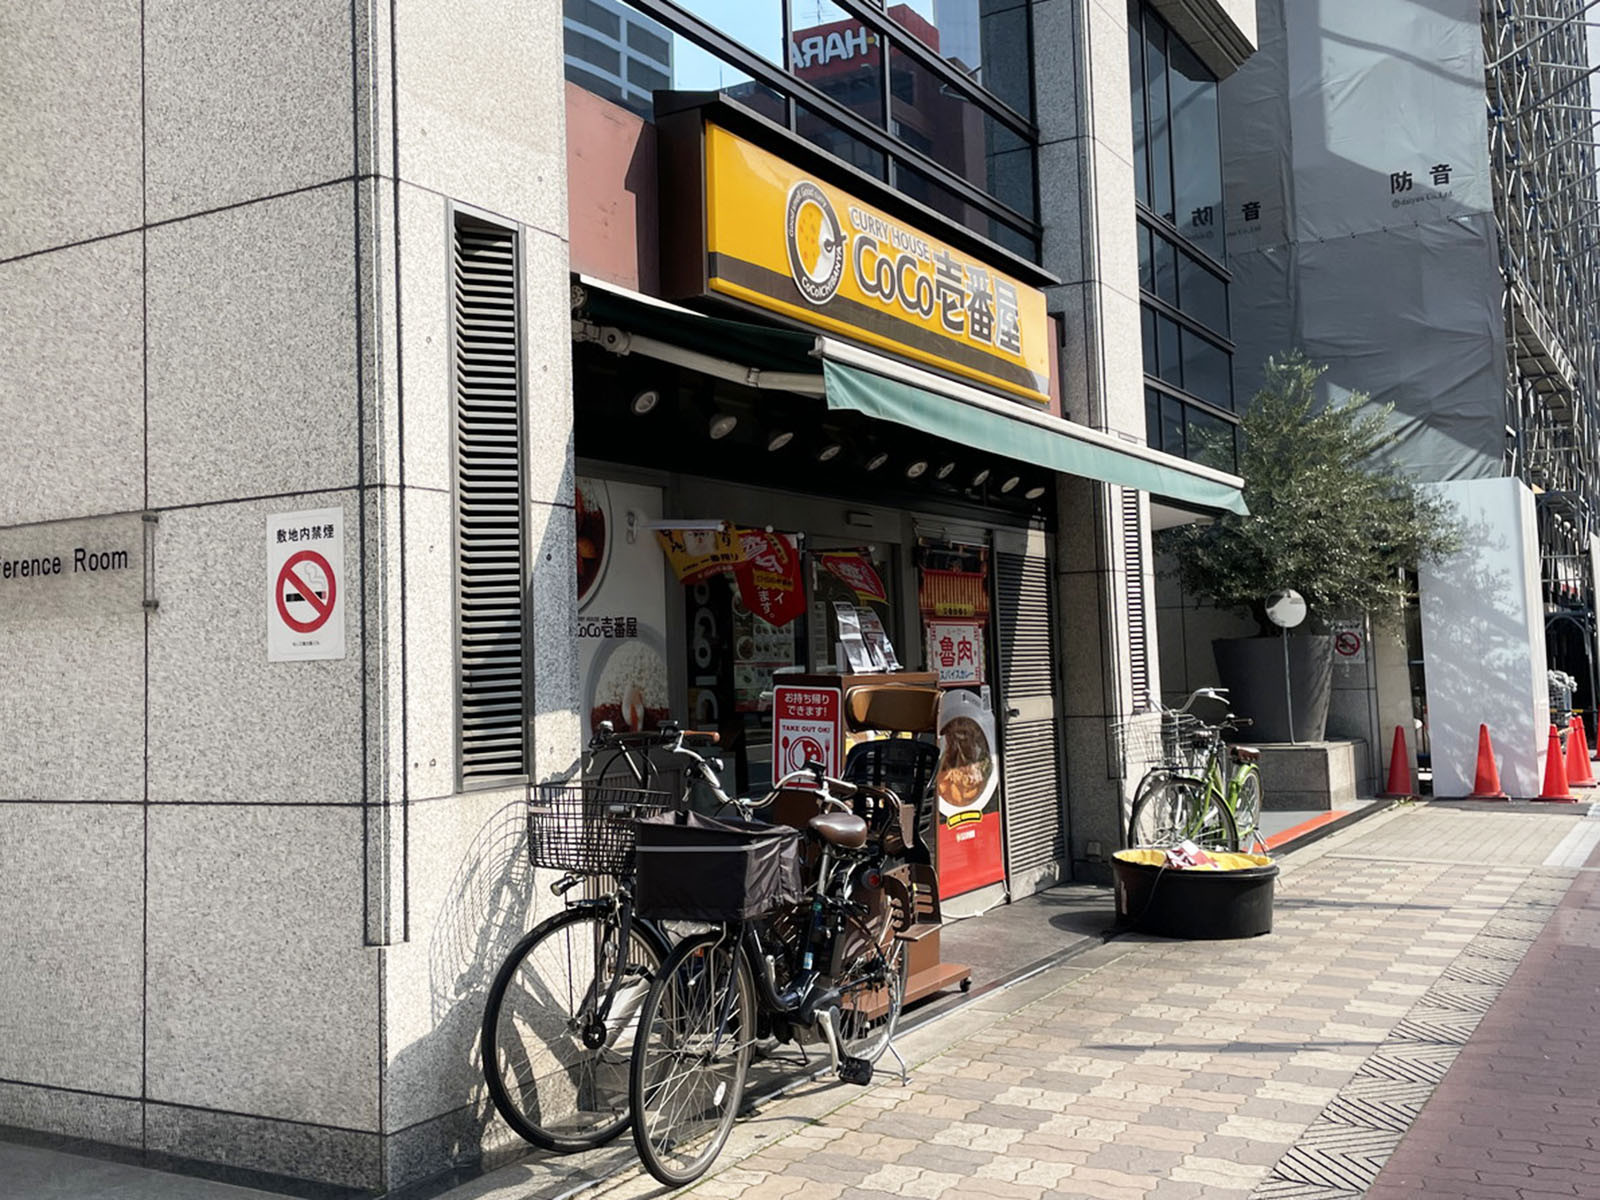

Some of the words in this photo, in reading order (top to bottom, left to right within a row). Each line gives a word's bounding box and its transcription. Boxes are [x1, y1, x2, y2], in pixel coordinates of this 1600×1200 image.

[851, 209, 889, 242] CURRY
[891, 229, 930, 262] HOUSE
[856, 235, 1021, 355] CoCo壱番屋
[276, 523, 335, 544] 敷地内禁煙
[0, 556, 61, 579] erence
[74, 547, 128, 573] Room
[577, 616, 638, 638] oCo壱番屋
[784, 692, 830, 705] お持ち帰り
[782, 724, 799, 732] TAKE
